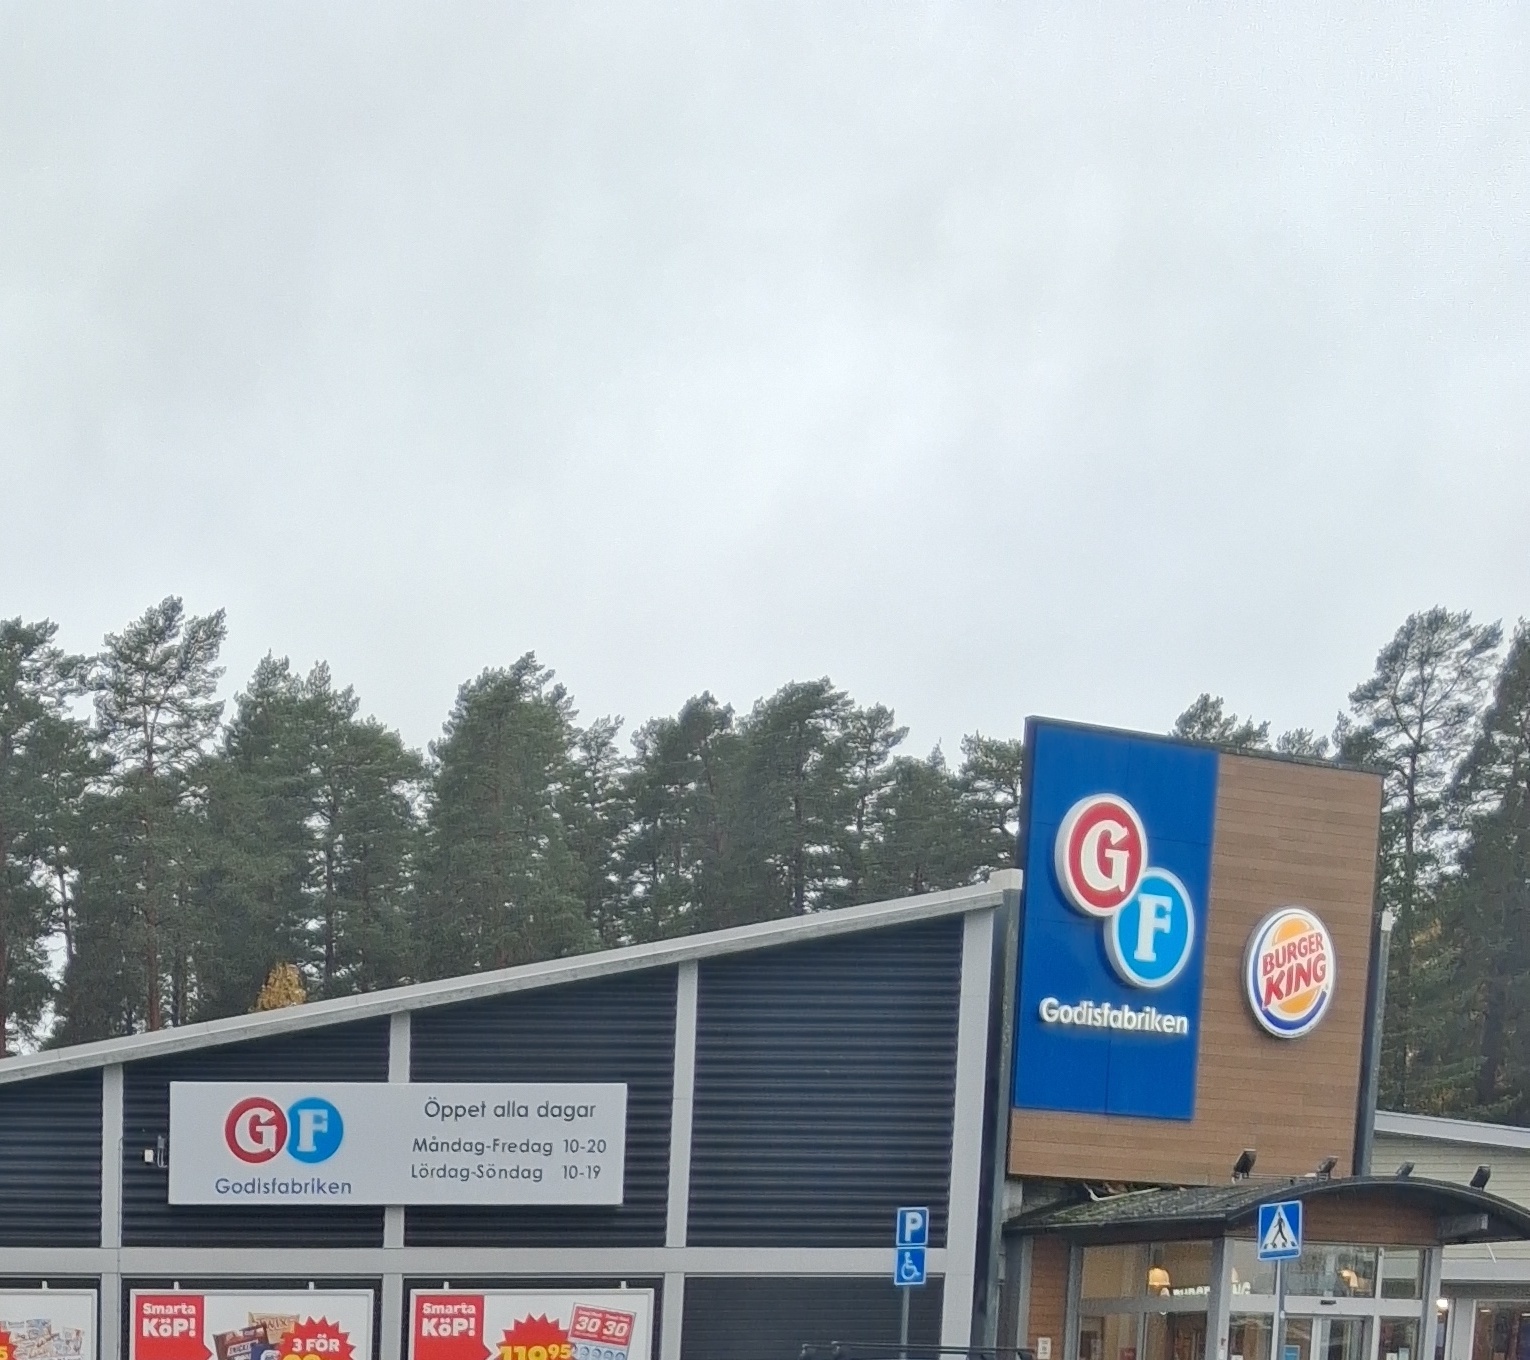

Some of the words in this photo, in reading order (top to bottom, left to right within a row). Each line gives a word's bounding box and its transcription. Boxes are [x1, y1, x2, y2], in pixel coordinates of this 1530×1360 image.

[1262, 930, 1324, 976] BURGER
[1263, 953, 1327, 1010] KING
[1038, 996, 1189, 1035] Godisfabriken
[424, 1096, 487, 1120] Öppet
[493, 1100, 529, 1119] alla
[537, 1100, 597, 1122] dagar
[412, 1136, 554, 1156] Måndag-Fredag
[562, 1138, 607, 1154] 10-20
[411, 1163, 544, 1182] Lördag-Söndag
[562, 1165, 601, 1181] 10-19
[215, 1177, 353, 1196] Godisfabriken
[904, 1211, 923, 1242] P
[142, 1302, 196, 1315] Smarta
[422, 1302, 476, 1315] Smarta
[291, 1337, 303, 1353] 3
[306, 1333, 340, 1353] FÖR
